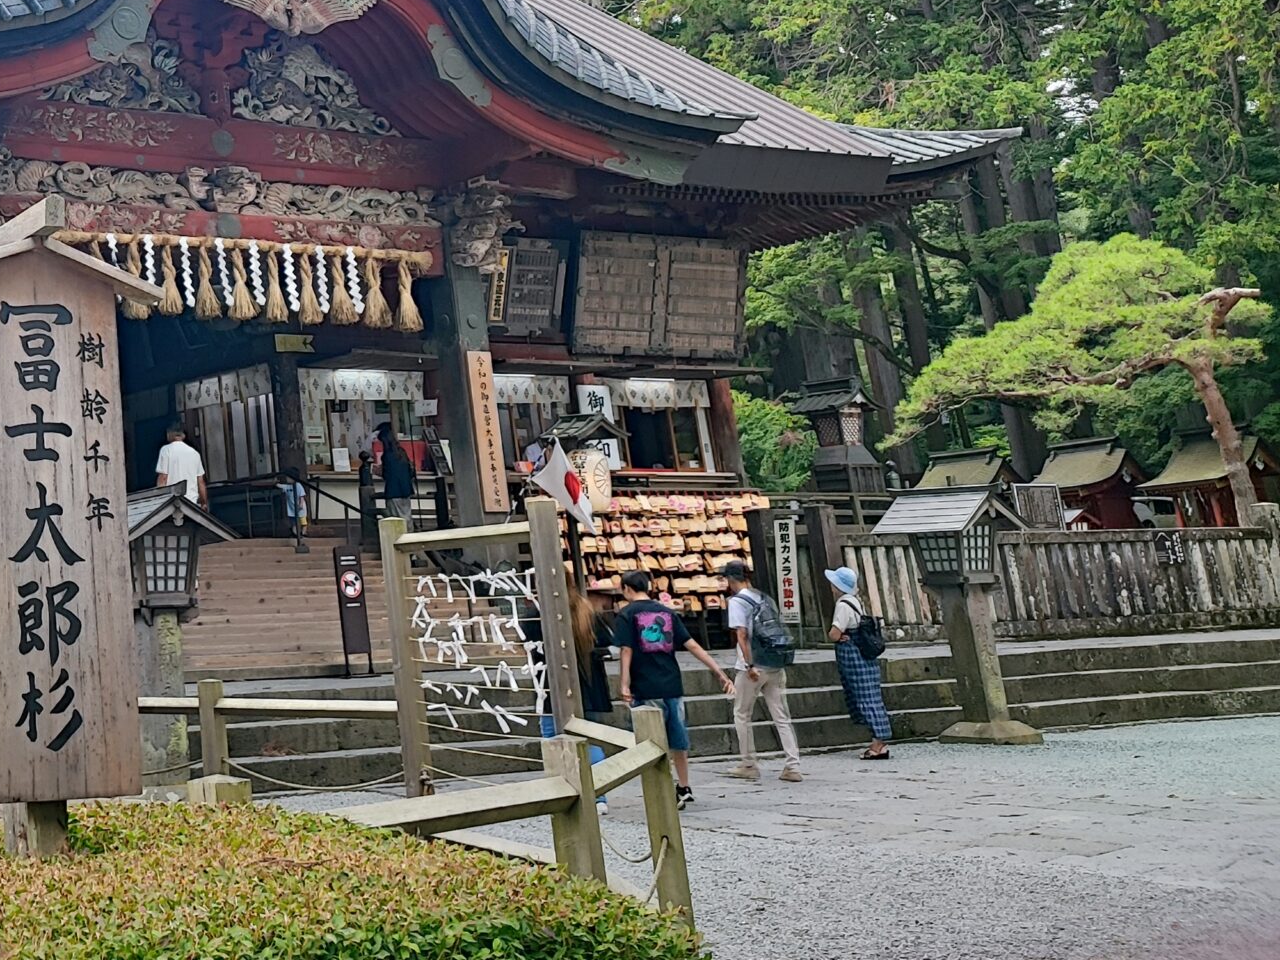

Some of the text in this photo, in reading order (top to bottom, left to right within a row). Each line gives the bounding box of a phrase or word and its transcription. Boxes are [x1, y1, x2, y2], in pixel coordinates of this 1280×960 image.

[75, 332, 115, 532] 樹齢千年
[778, 522, 794, 610] 防犯カメラ作動中
